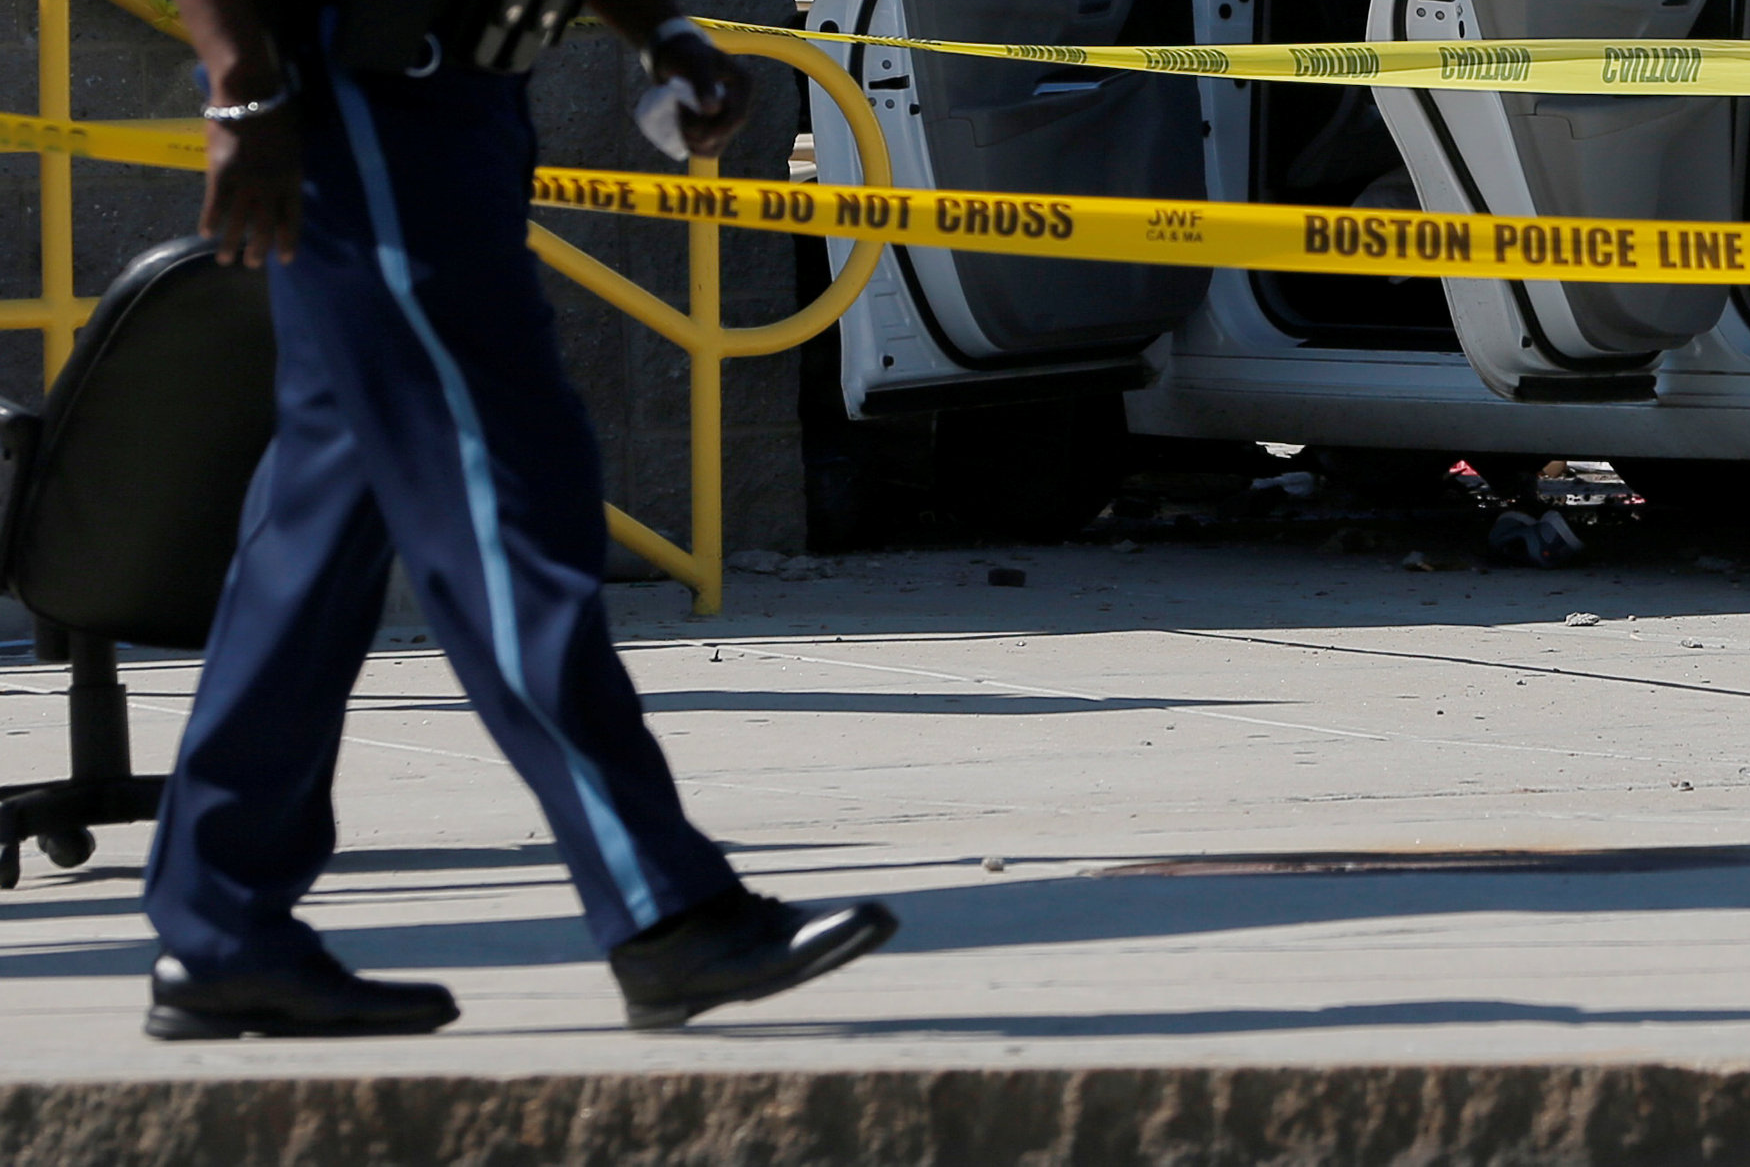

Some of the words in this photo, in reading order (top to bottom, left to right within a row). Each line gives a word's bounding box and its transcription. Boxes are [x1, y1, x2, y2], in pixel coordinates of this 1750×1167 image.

[656, 183, 739, 219] LINE
[759, 188, 815, 224] DO
[834, 192, 914, 231] NOT
[935, 196, 1076, 241] CROSS
[1147, 209, 1203, 230] JWF
[1304, 214, 1471, 263] BOSTON
[1494, 223, 1637, 270] POLICE
[1658, 229, 1746, 271] LINE
